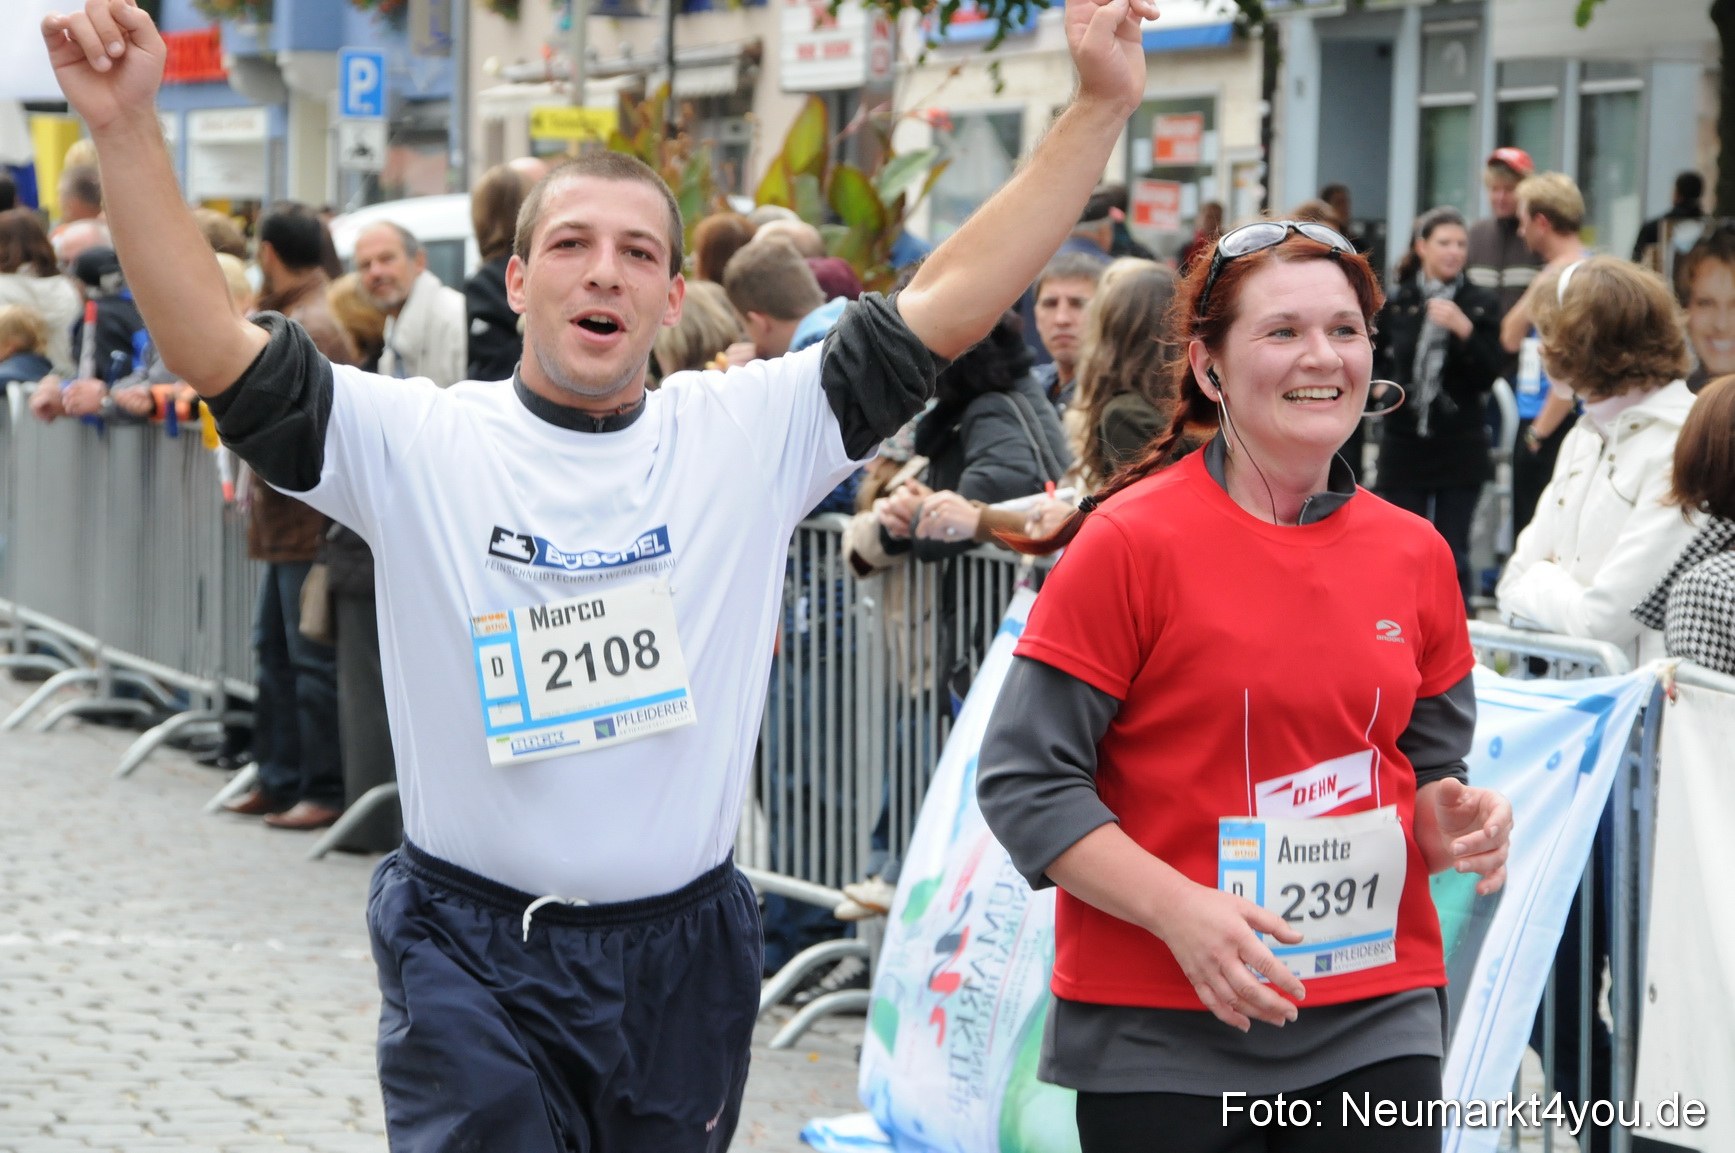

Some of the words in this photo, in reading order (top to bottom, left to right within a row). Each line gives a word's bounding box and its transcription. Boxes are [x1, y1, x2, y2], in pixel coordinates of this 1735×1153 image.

[545, 532, 666, 570] BÜSCHEL
[484, 559, 595, 584] FEINSCHNEIDTECHNIK
[529, 598, 606, 632] Marco
[491, 656, 504, 678] D
[540, 628, 661, 693] 2108
[616, 700, 690, 728] PFLEIDERER
[1292, 773, 1338, 807] DEHN
[1277, 835, 1351, 865] Anette
[1280, 872, 1380, 923] 2391
